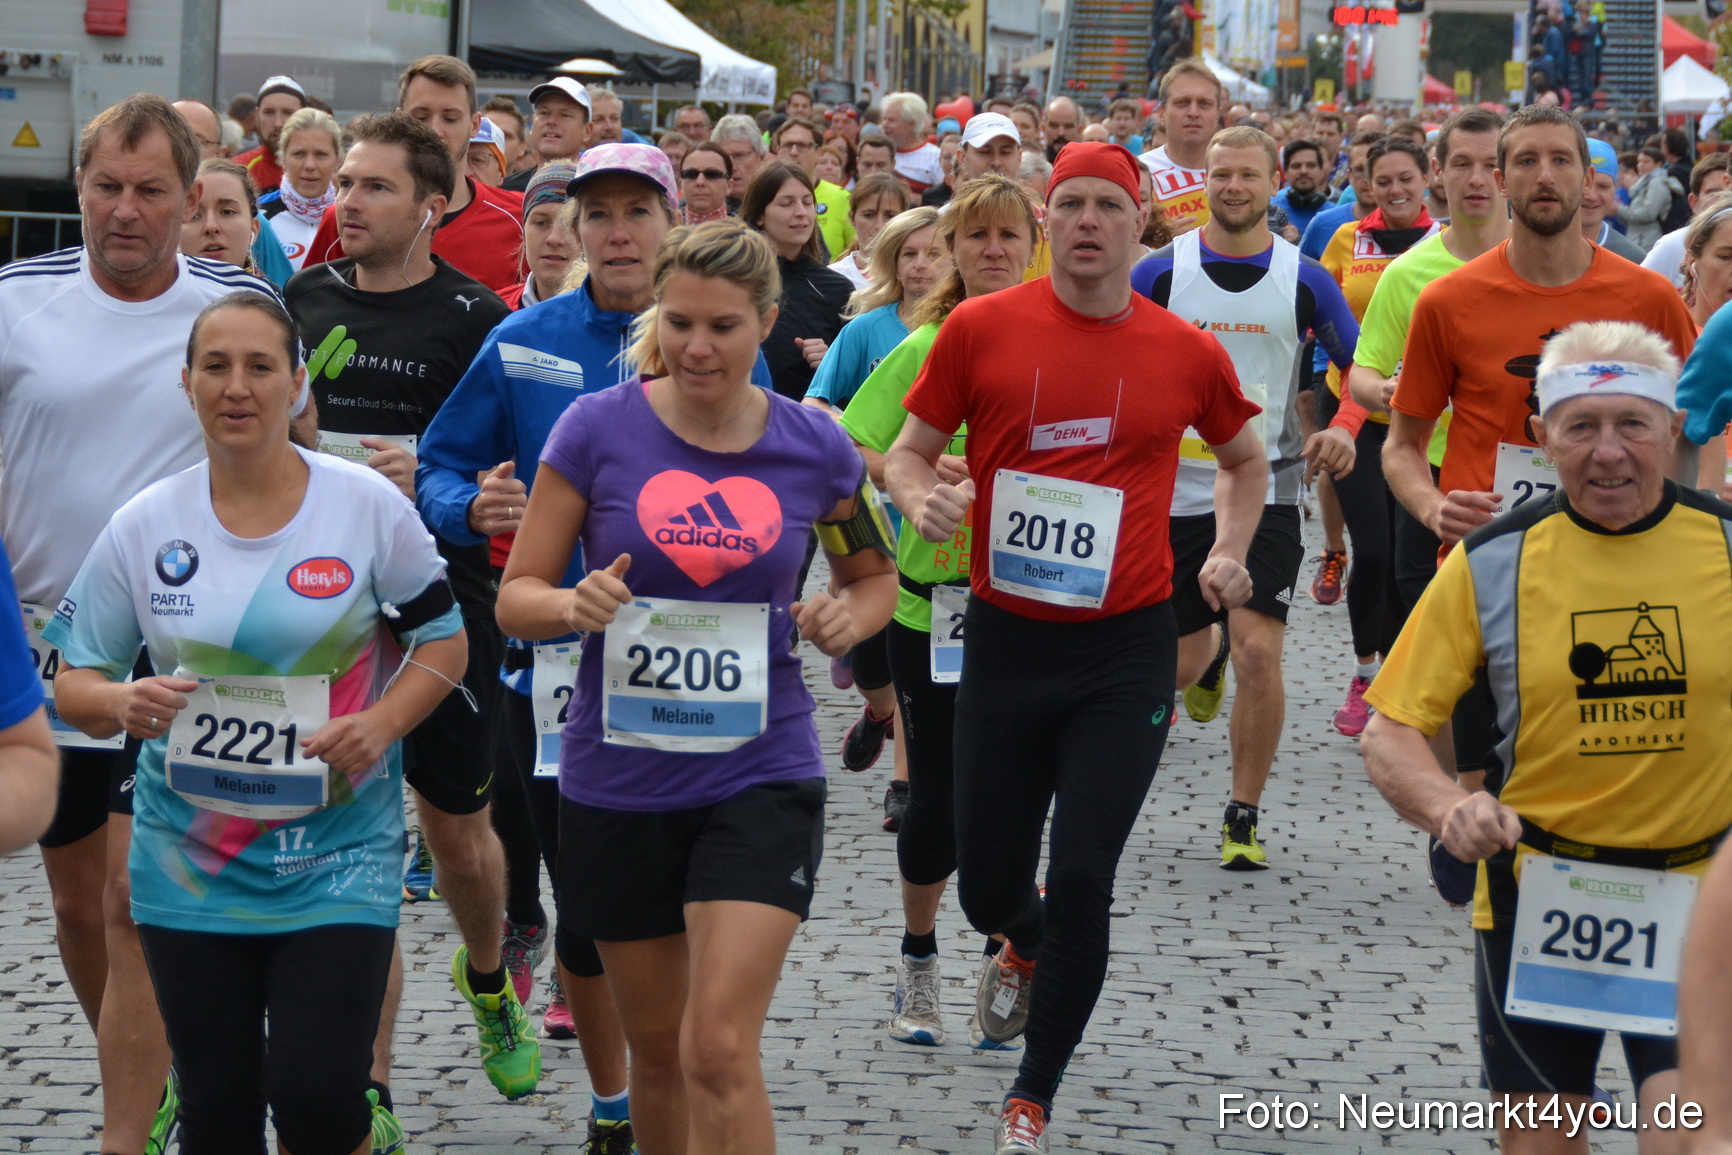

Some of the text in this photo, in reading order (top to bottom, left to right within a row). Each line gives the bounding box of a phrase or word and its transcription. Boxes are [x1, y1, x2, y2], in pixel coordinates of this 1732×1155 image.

[1164, 197, 1206, 218] MAX
[1351, 263, 1387, 275] MAX
[1211, 322, 1270, 334] KLEBL
[540, 358, 559, 367] JAKO
[327, 394, 356, 406] Secure
[357, 397, 380, 408] Cloud
[1053, 427, 1089, 441] DEHN
[1039, 488, 1083, 504] BOCK
[655, 526, 759, 553] adidas
[1006, 511, 1095, 559] 2018
[297, 567, 347, 588] Hervis
[1023, 563, 1064, 582] Robert
[151, 593, 195, 607] PARTL
[151, 606, 194, 616] Neumarkt
[666, 615, 720, 627] BOCK
[627, 644, 742, 692] 2206
[232, 686, 286, 703] BOCK
[652, 706, 714, 725] Melanie
[1579, 699, 1686, 723] HIRSCH
[191, 713, 297, 765] 2221
[1580, 733, 1685, 746] APOTHEKE
[213, 775, 276, 795] Melanie
[274, 826, 313, 852] 17.
[1586, 879, 1645, 898] BOCK
[1540, 909, 1658, 969] 2921
